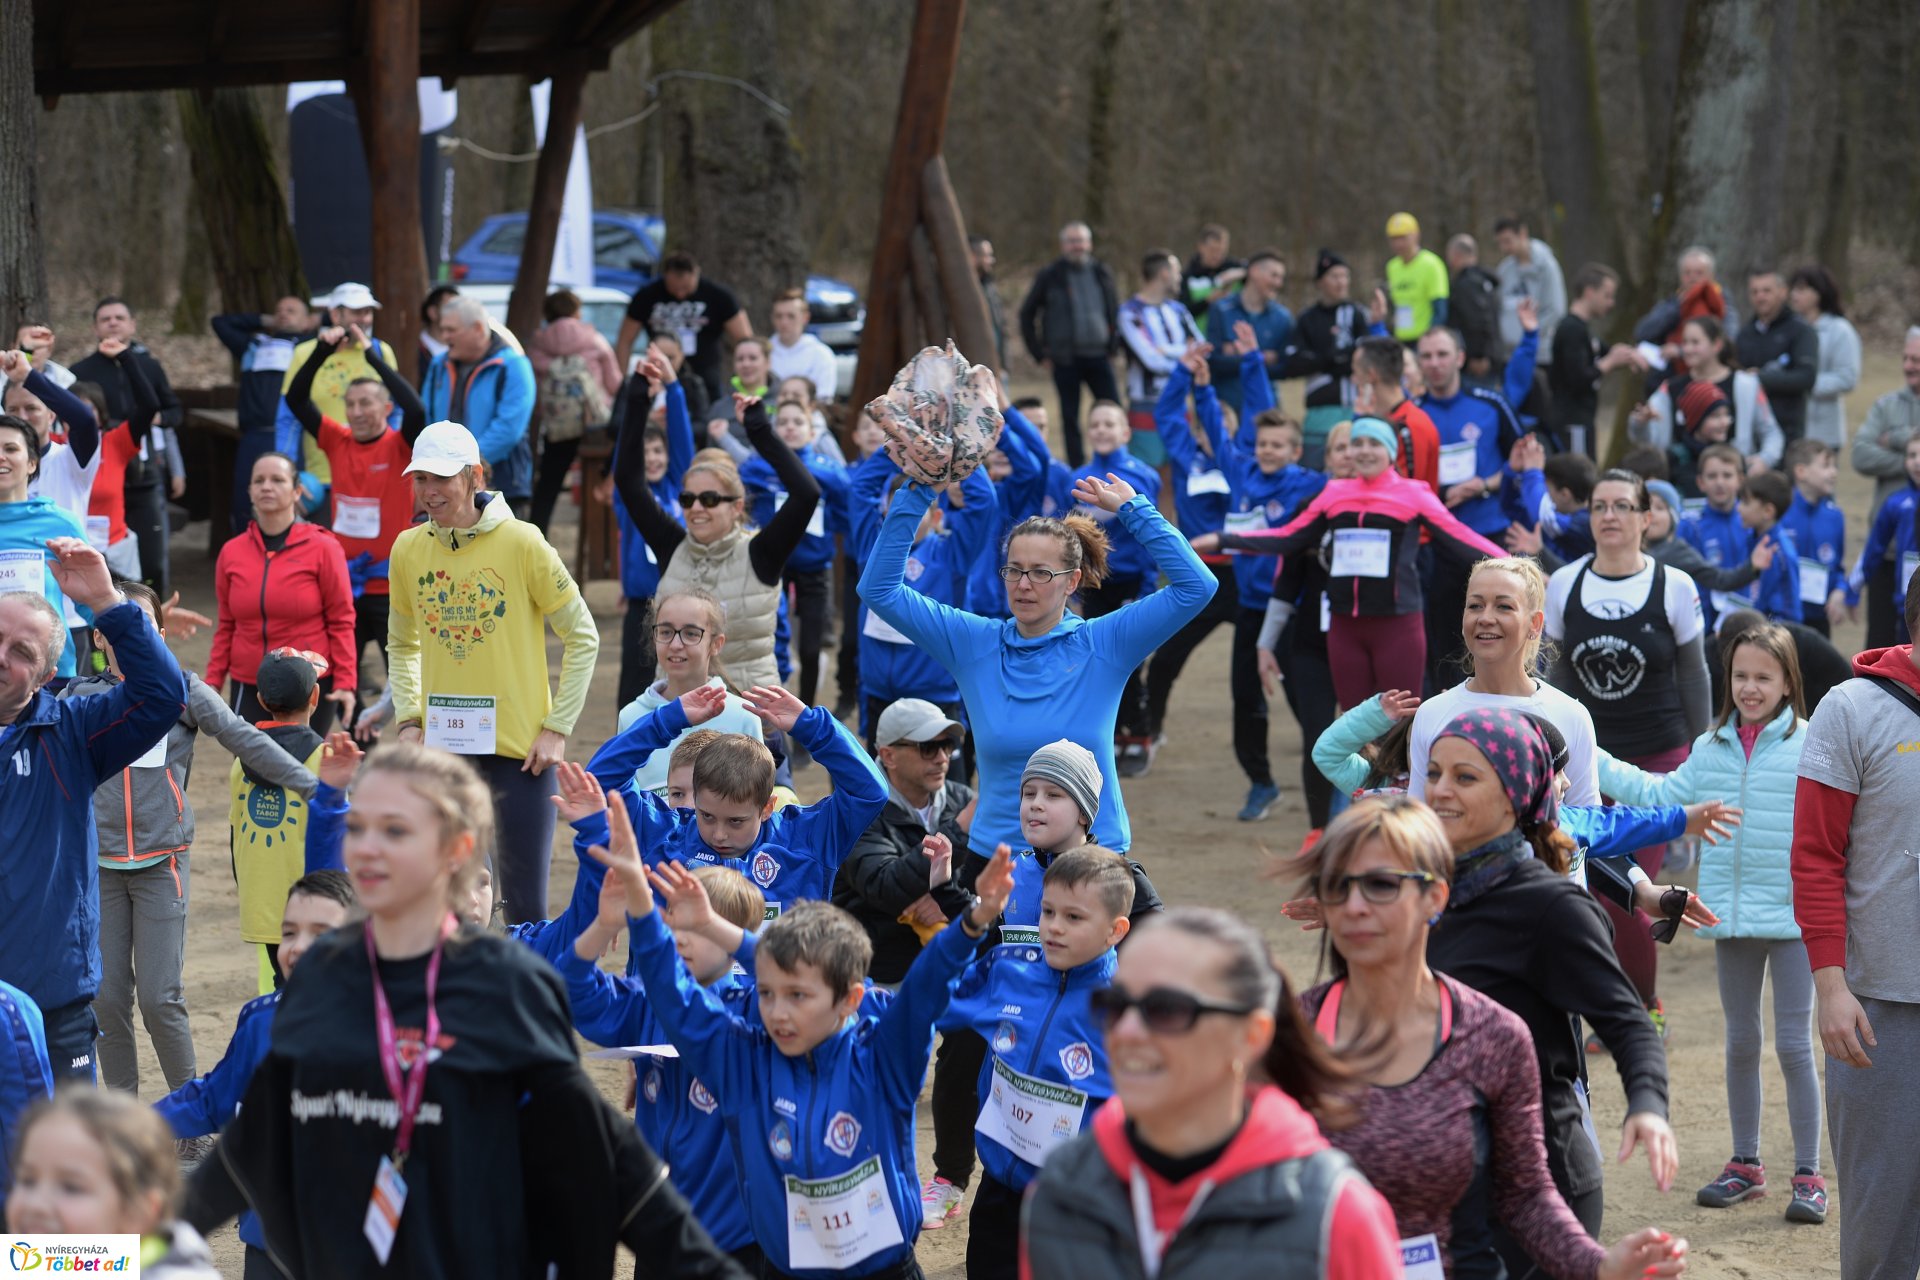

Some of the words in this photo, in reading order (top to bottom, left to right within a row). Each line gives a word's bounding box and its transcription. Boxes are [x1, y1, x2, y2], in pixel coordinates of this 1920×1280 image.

[440, 606, 455, 615] THIS
[456, 606, 464, 615] IS
[465, 605, 477, 614] MY
[431, 698, 446, 706] SPURI
[447, 719, 464, 729] 183
[256, 801, 280, 810] BÁTOR
[256, 809, 279, 817] TÁBOR
[695, 852, 715, 862] JAKO
[1006, 933, 1020, 941] SPURI
[1002, 1004, 1022, 1015] JAKO
[71, 1054, 90, 1068] JAKO
[335, 1089, 443, 1130] Nyíregyza
[774, 1096, 797, 1113] JAKO
[1011, 1103, 1033, 1124] 107
[822, 1210, 853, 1230] 111
